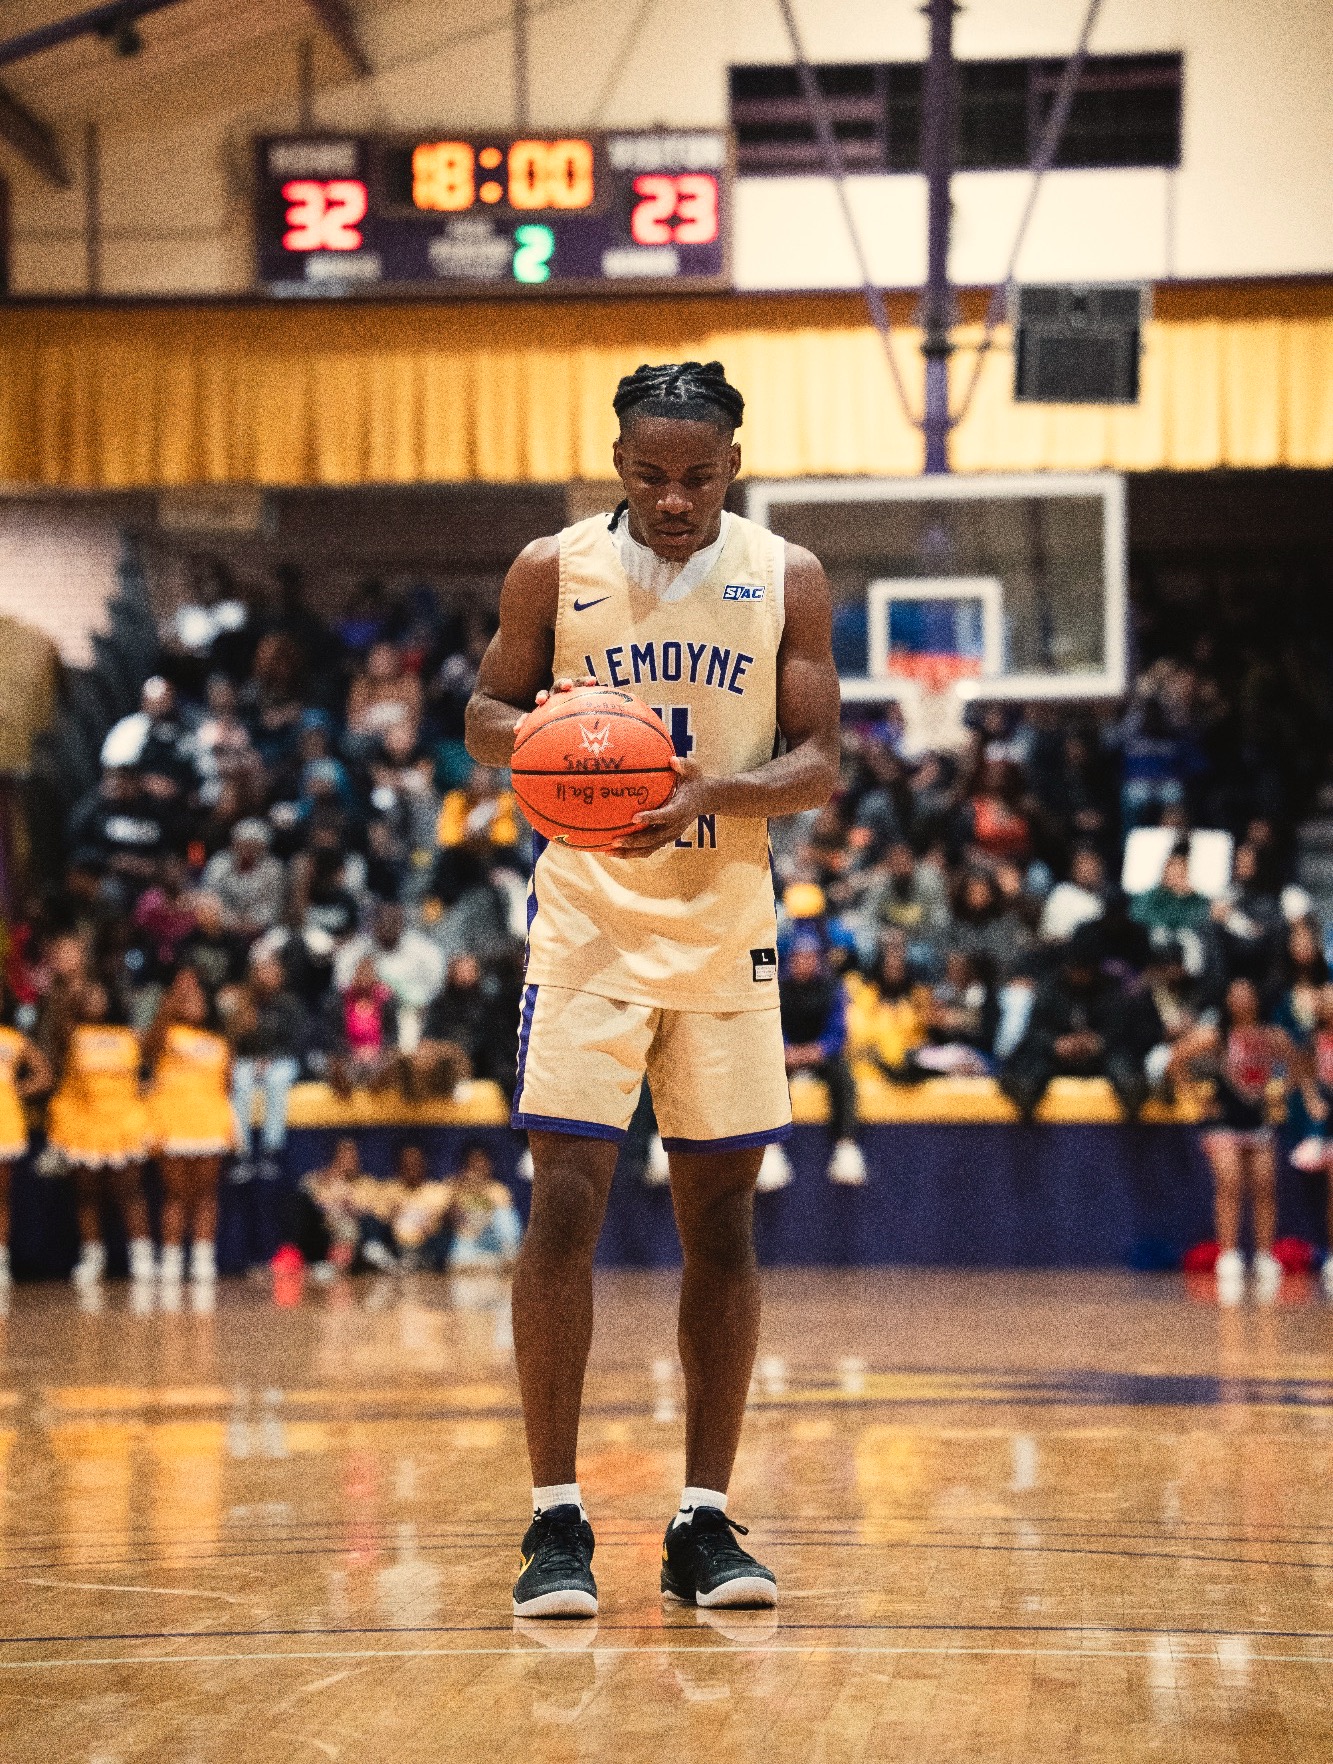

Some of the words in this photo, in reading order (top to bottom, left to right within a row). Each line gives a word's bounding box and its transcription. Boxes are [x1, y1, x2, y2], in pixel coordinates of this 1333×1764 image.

[412, 140, 594, 211] 18:00
[281, 179, 369, 252] 32
[631, 173, 719, 245] 23
[513, 224, 555, 283] 2
[724, 585, 765, 600] SIAC
[585, 642, 754, 695] LEMOYNE
[557, 782, 594, 805] Ball
[600, 785, 649, 805] Game
[761, 952, 769, 962] L
